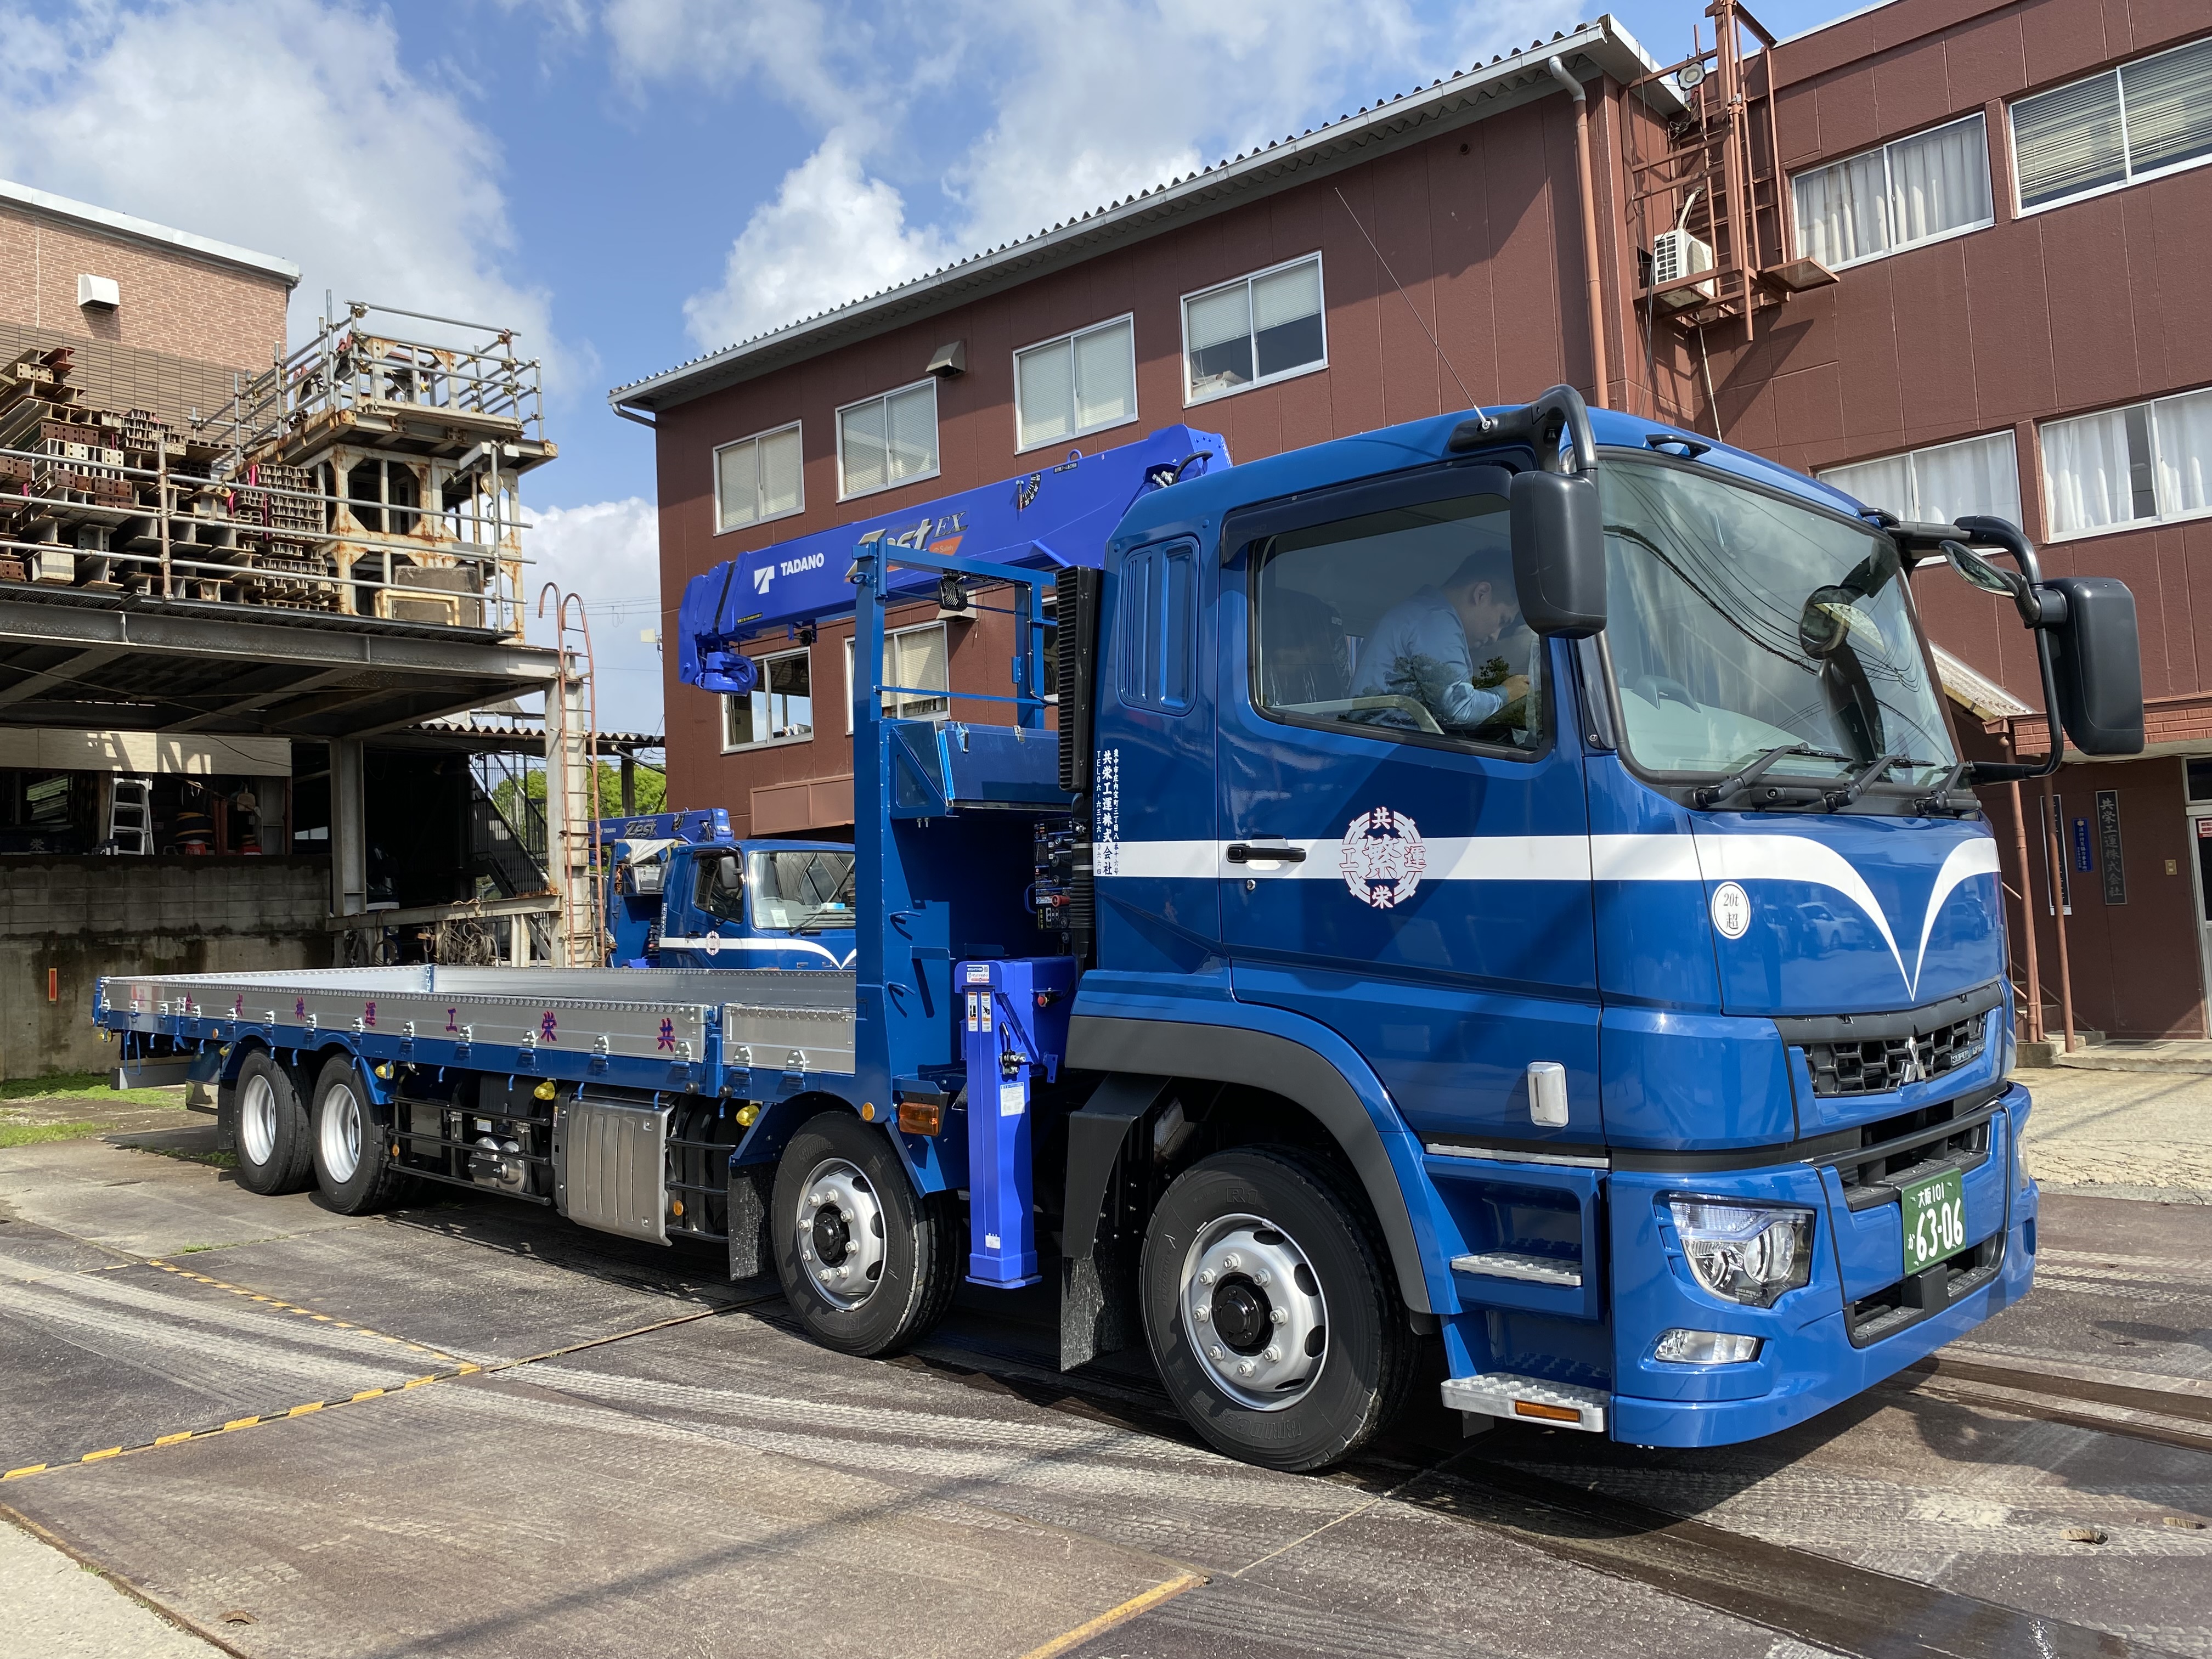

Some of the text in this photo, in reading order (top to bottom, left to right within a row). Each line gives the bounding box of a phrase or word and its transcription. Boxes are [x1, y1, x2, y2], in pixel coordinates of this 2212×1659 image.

[933, 511, 966, 539] EX
[780, 552, 825, 576] TADANO
[1102, 750, 1113, 875] 共栄工運株式会社
[1372, 806, 1392, 830] 共
[624, 819, 657, 838] Zest
[1404, 845, 1427, 870] 運
[2100, 798, 2123, 898] 共栄工運株式会社
[1371, 885, 1393, 909] 栄
[1723, 893, 1739, 907] 20t
[1725, 912, 1739, 930] 超
[1916, 1197, 1963, 1262] 63-06
